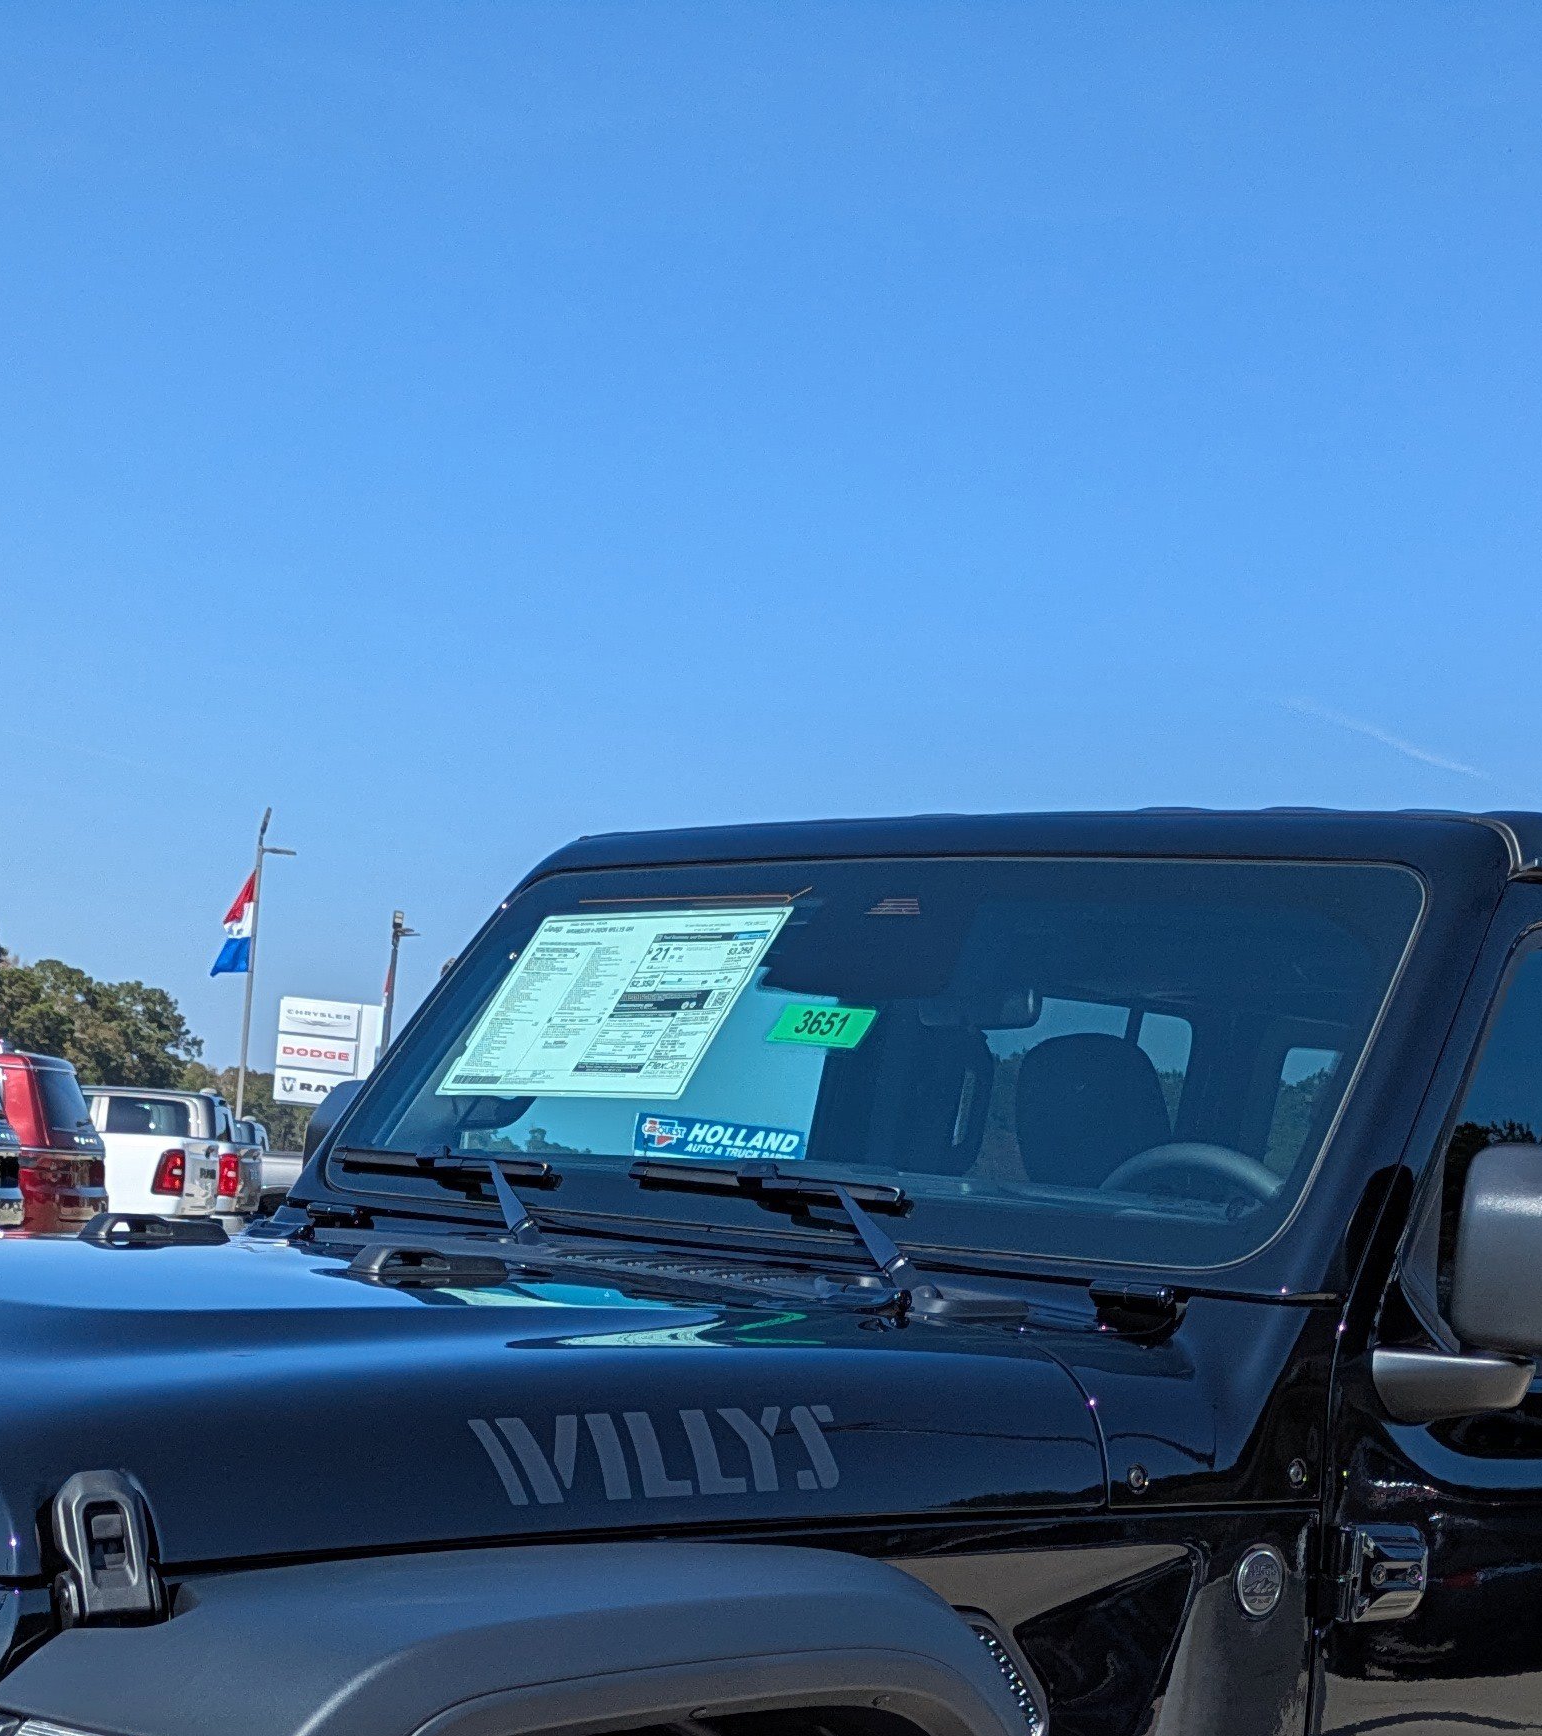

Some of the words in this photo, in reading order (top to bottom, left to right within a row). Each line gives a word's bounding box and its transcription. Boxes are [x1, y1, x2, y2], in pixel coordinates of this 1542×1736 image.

[651, 947, 671, 960] 21
[287, 1009, 351, 1020] CHRYSLER
[794, 1010, 851, 1037] 3651
[282, 1046, 350, 1061] DODGE
[686, 1122, 800, 1153] HOLLAND
[684, 1143, 714, 1154] AUTO
[715, 1146, 724, 1156] &
[725, 1147, 759, 1159] TRUCK
[467, 1404, 841, 1506] WILLYS
